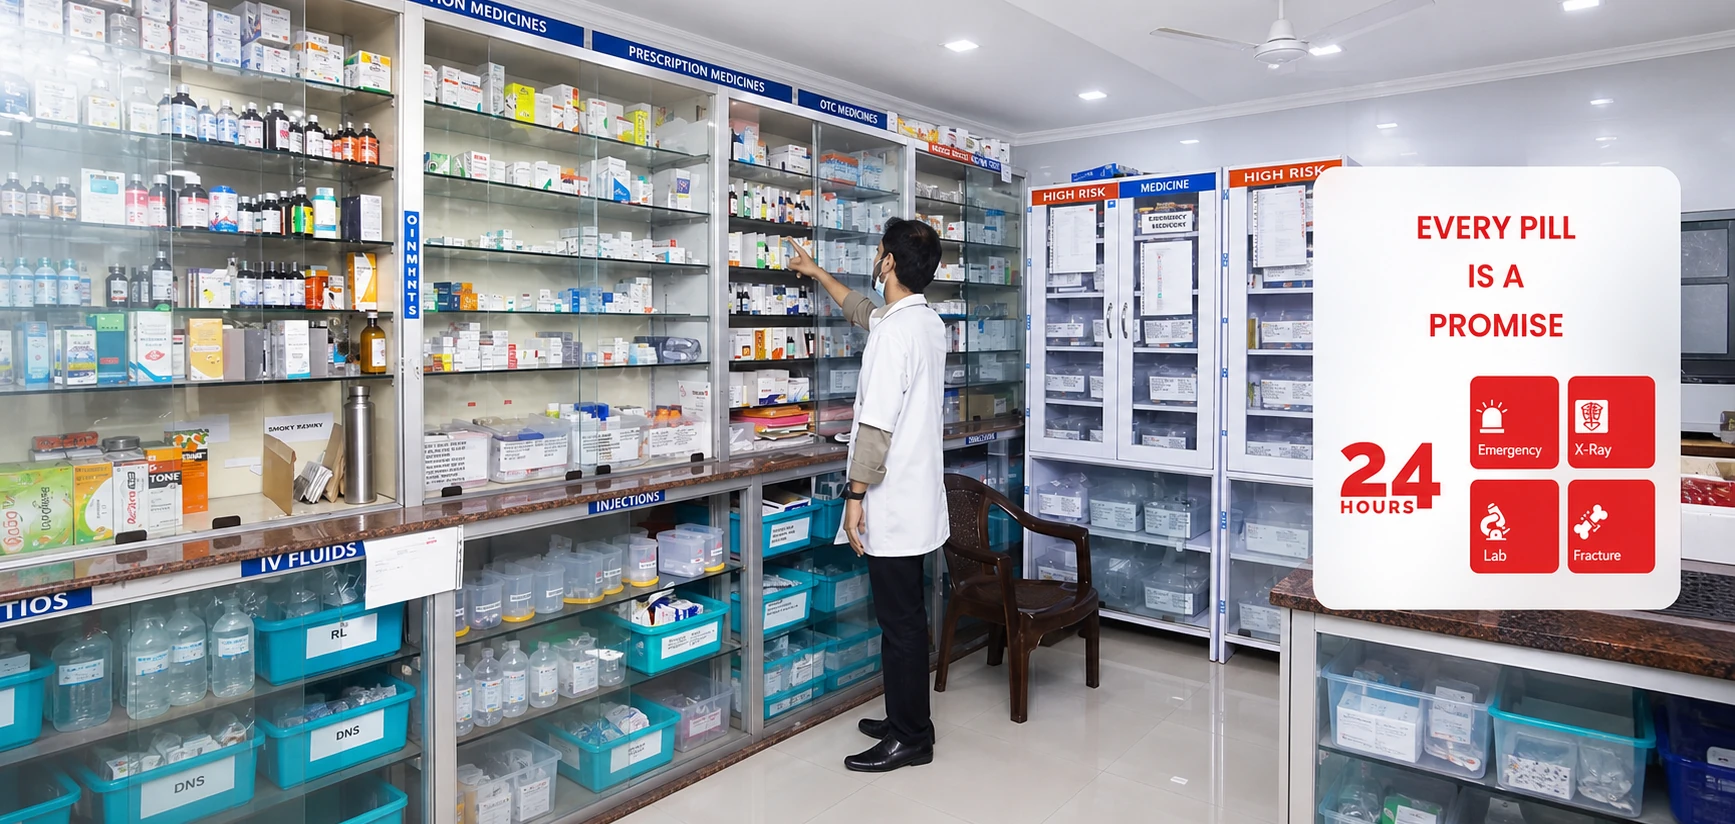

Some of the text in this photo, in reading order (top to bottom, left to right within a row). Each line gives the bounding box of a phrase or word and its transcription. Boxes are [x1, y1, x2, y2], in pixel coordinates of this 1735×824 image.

[471, 1, 547, 33] MEDICINES
[629, 45, 765, 92] PRESCRIPTION MEDICINES
[820, 99, 878, 124] OTC MEDICINES
[1244, 164, 1325, 183] HIGH RISK
[1043, 186, 1106, 202] HIGH RISK
[1140, 179, 1190, 193] MEDICINE
[149, 472, 181, 483] TONE
[596, 491, 660, 512] INJECTIONS
[261, 542, 357, 572] IV FLUIDS
[0, 592, 68, 619] TIOS
[331, 628, 347, 640] RL
[336, 725, 360, 741] DNS
[174, 775, 205, 794] DNS
